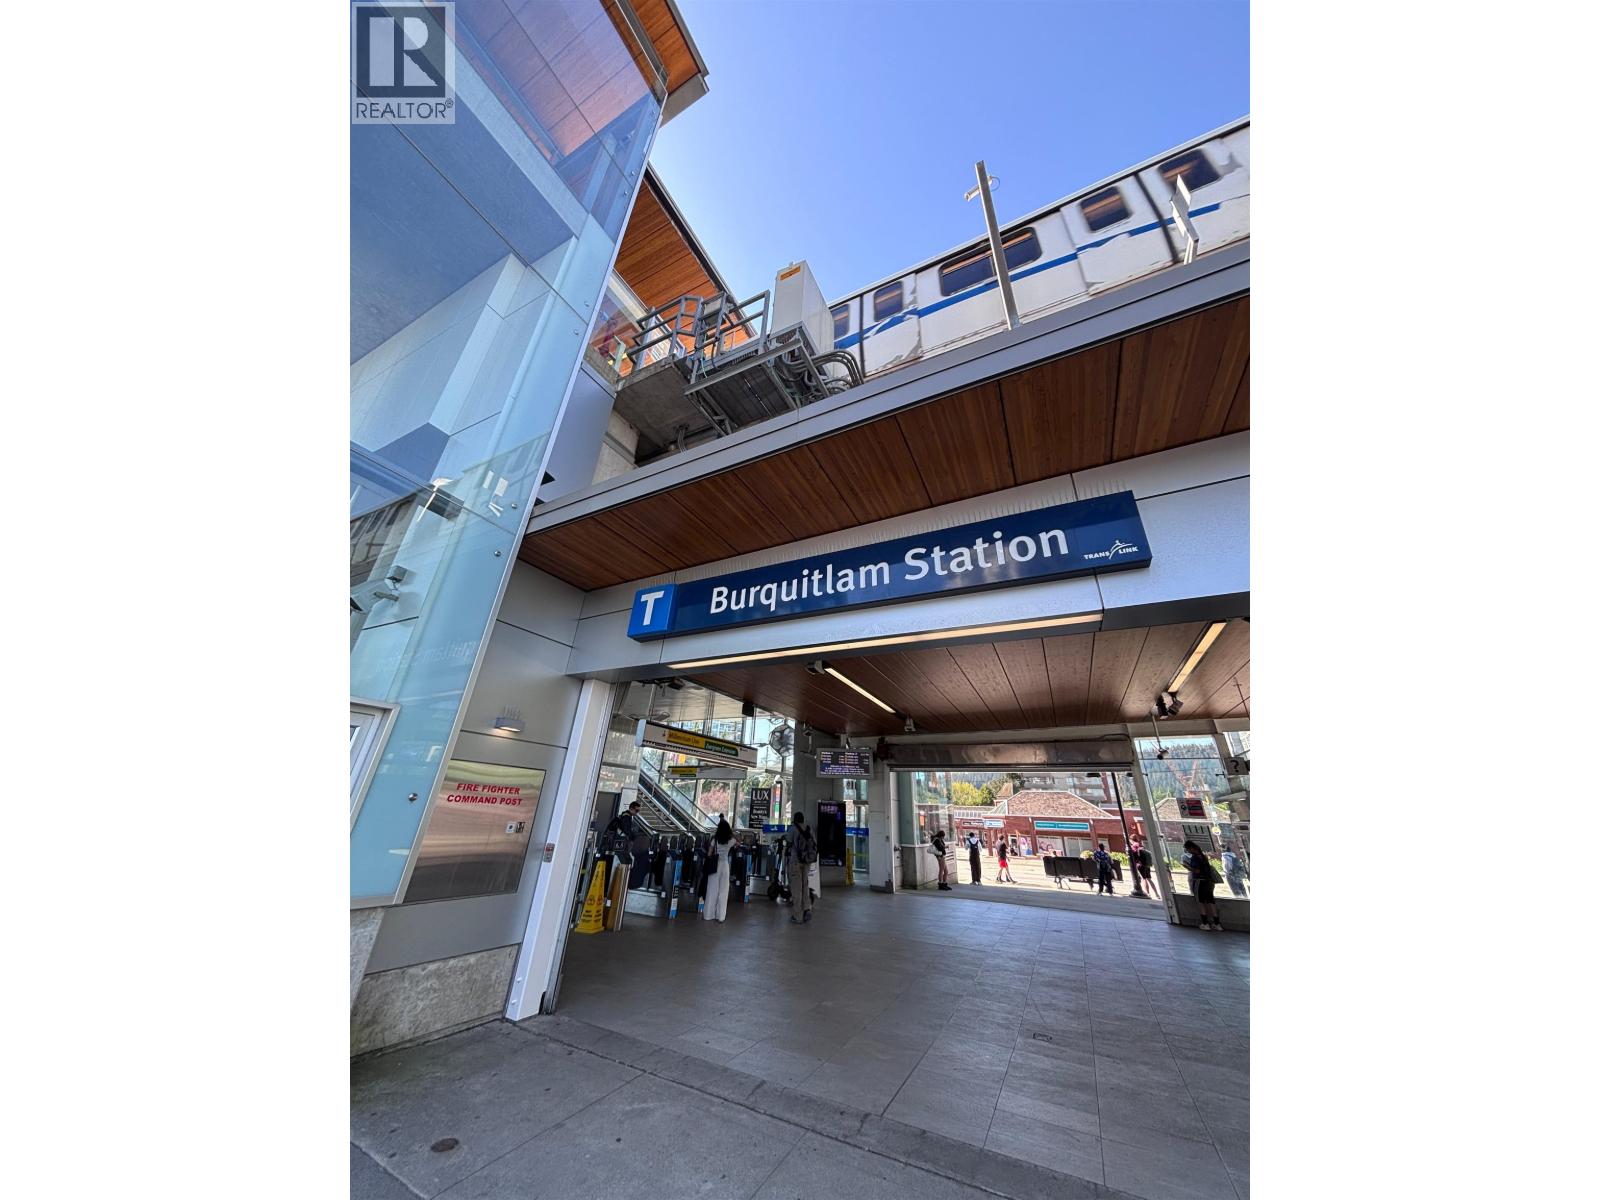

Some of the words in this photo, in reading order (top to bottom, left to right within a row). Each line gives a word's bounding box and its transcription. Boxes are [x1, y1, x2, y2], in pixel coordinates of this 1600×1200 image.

[709, 559, 890, 614] Burquitlam
[904, 528, 1069, 581] Station
[640, 590, 665, 626] T
[456, 783, 480, 791] FIRE
[481, 784, 521, 795] FIGHTER
[752, 790, 769, 800] LUX
[447, 794, 497, 805] COMMAND
[499, 797, 523, 806] POST
